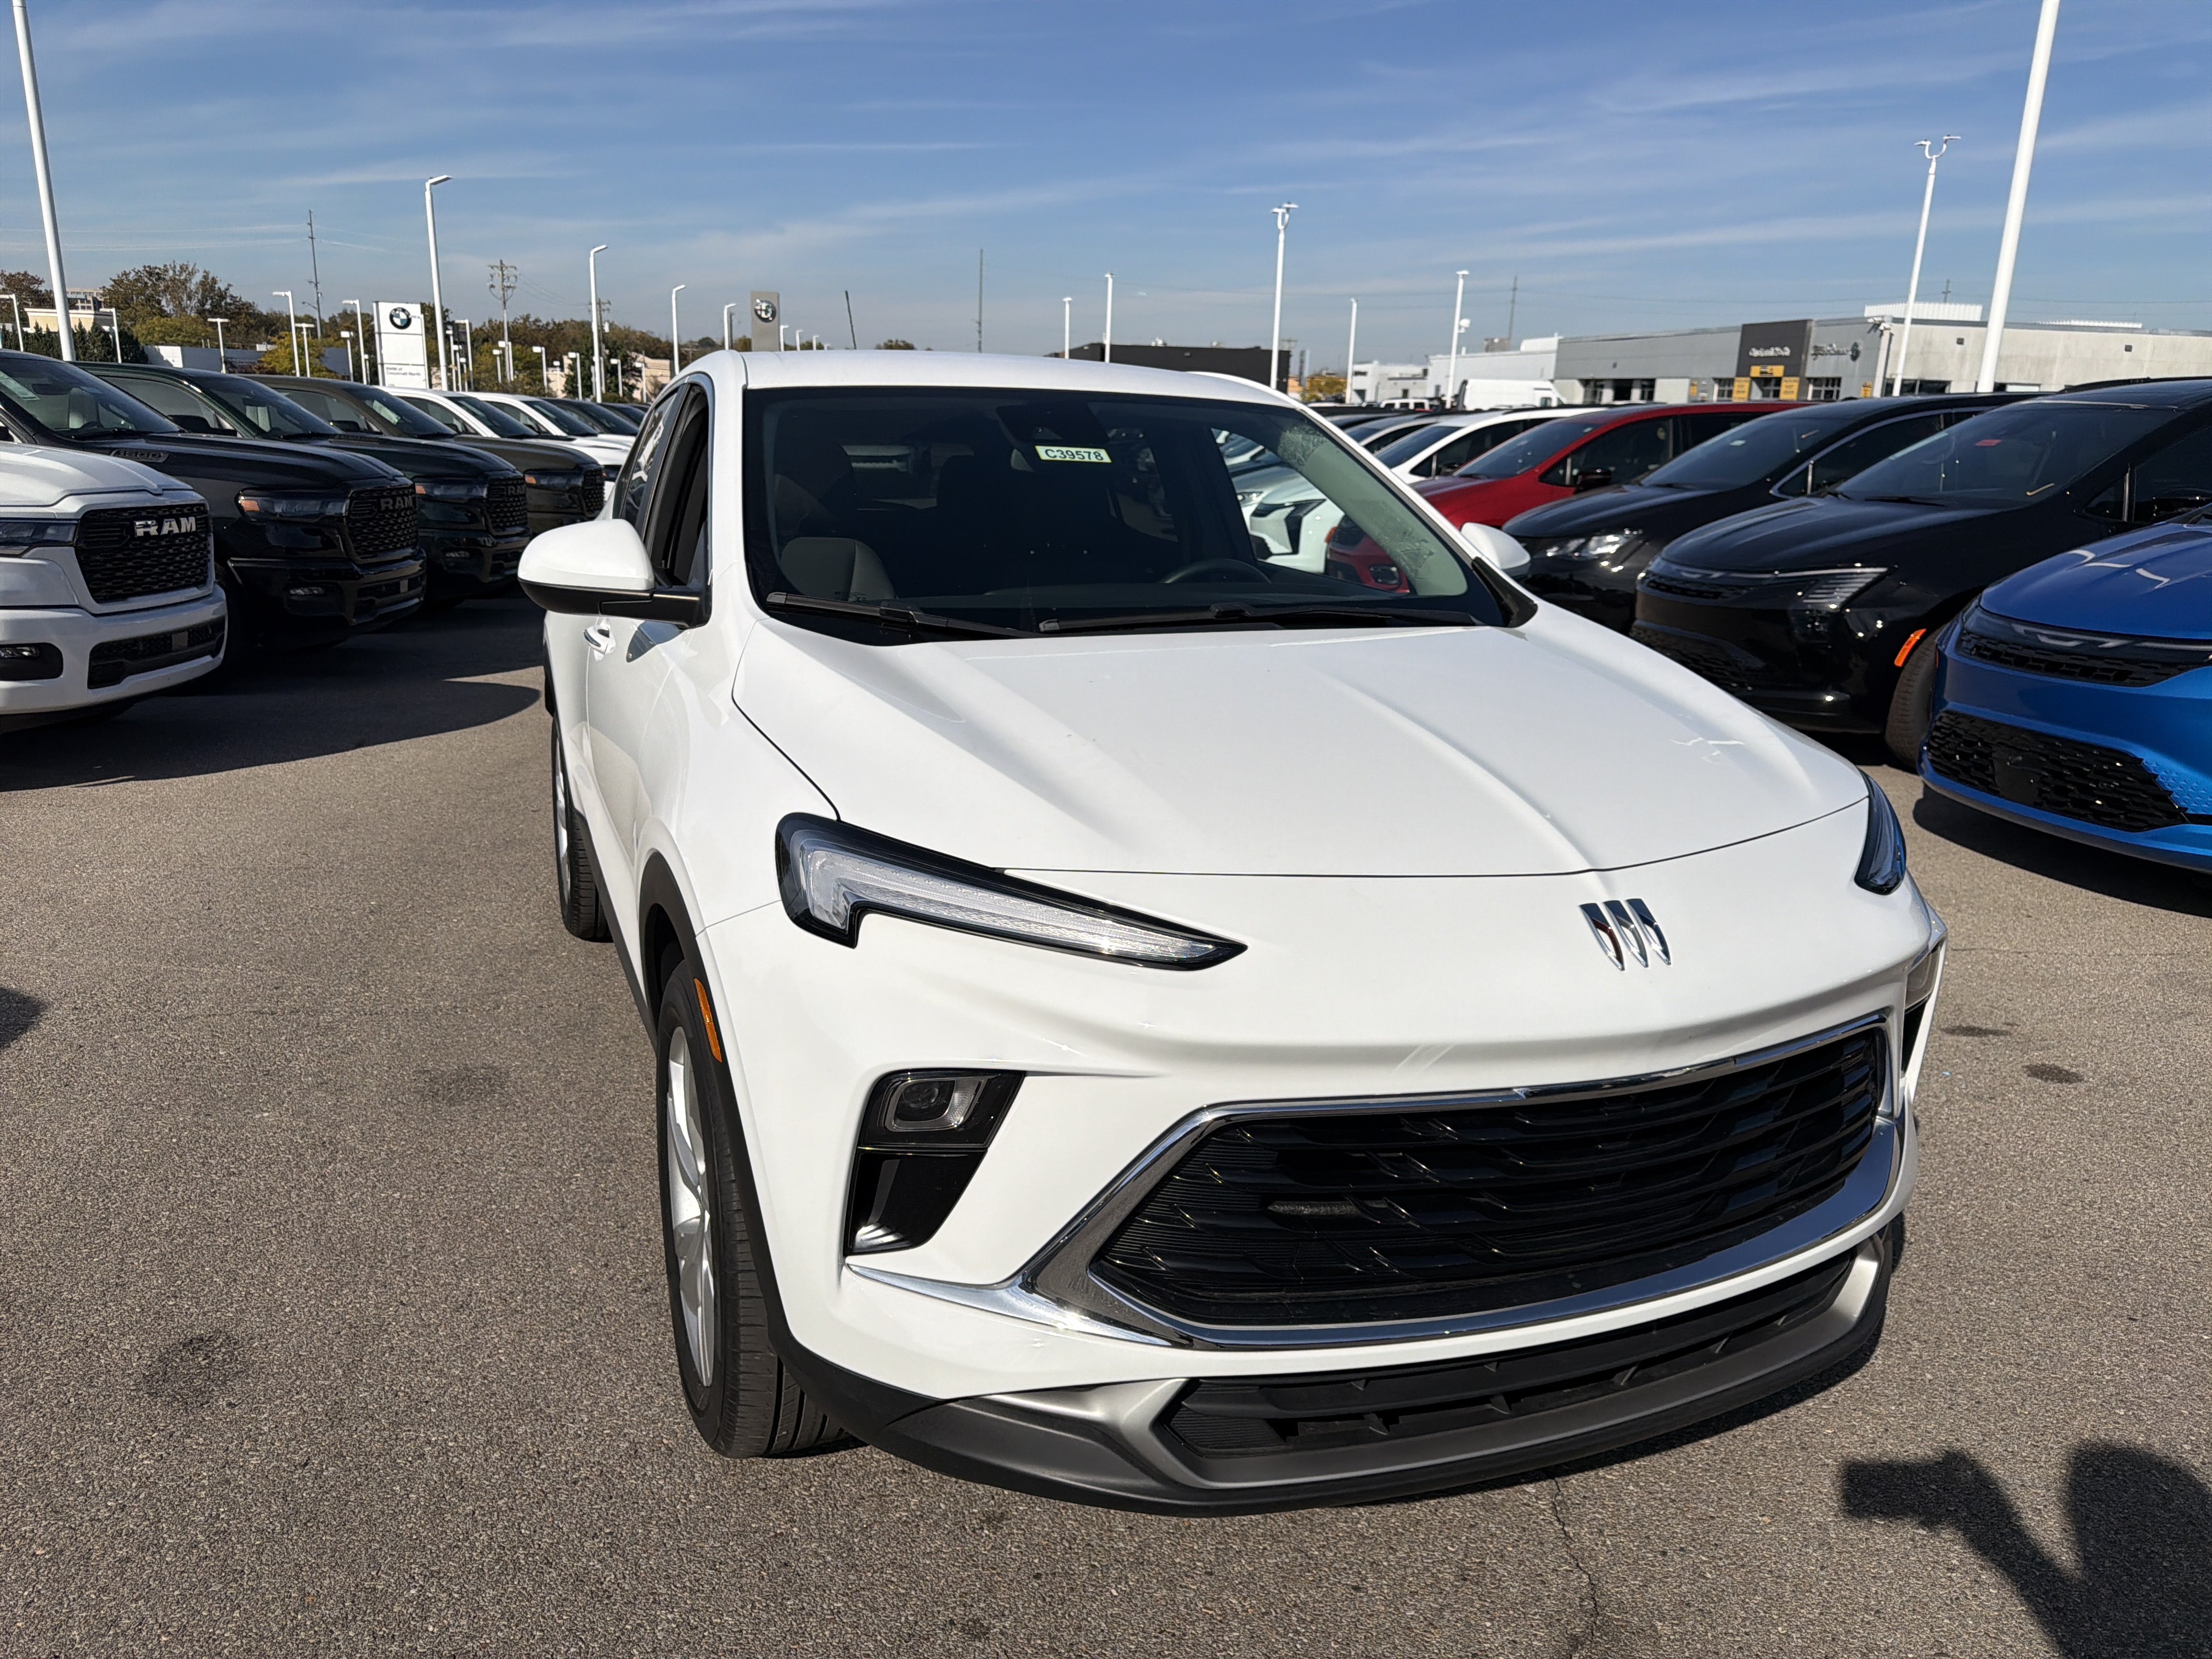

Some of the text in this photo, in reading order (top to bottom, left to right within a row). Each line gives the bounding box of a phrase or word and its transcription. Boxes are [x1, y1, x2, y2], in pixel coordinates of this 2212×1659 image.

[1045, 449, 1104, 461] C39578
[380, 496, 413, 510] RAM
[133, 516, 196, 537] RAM
